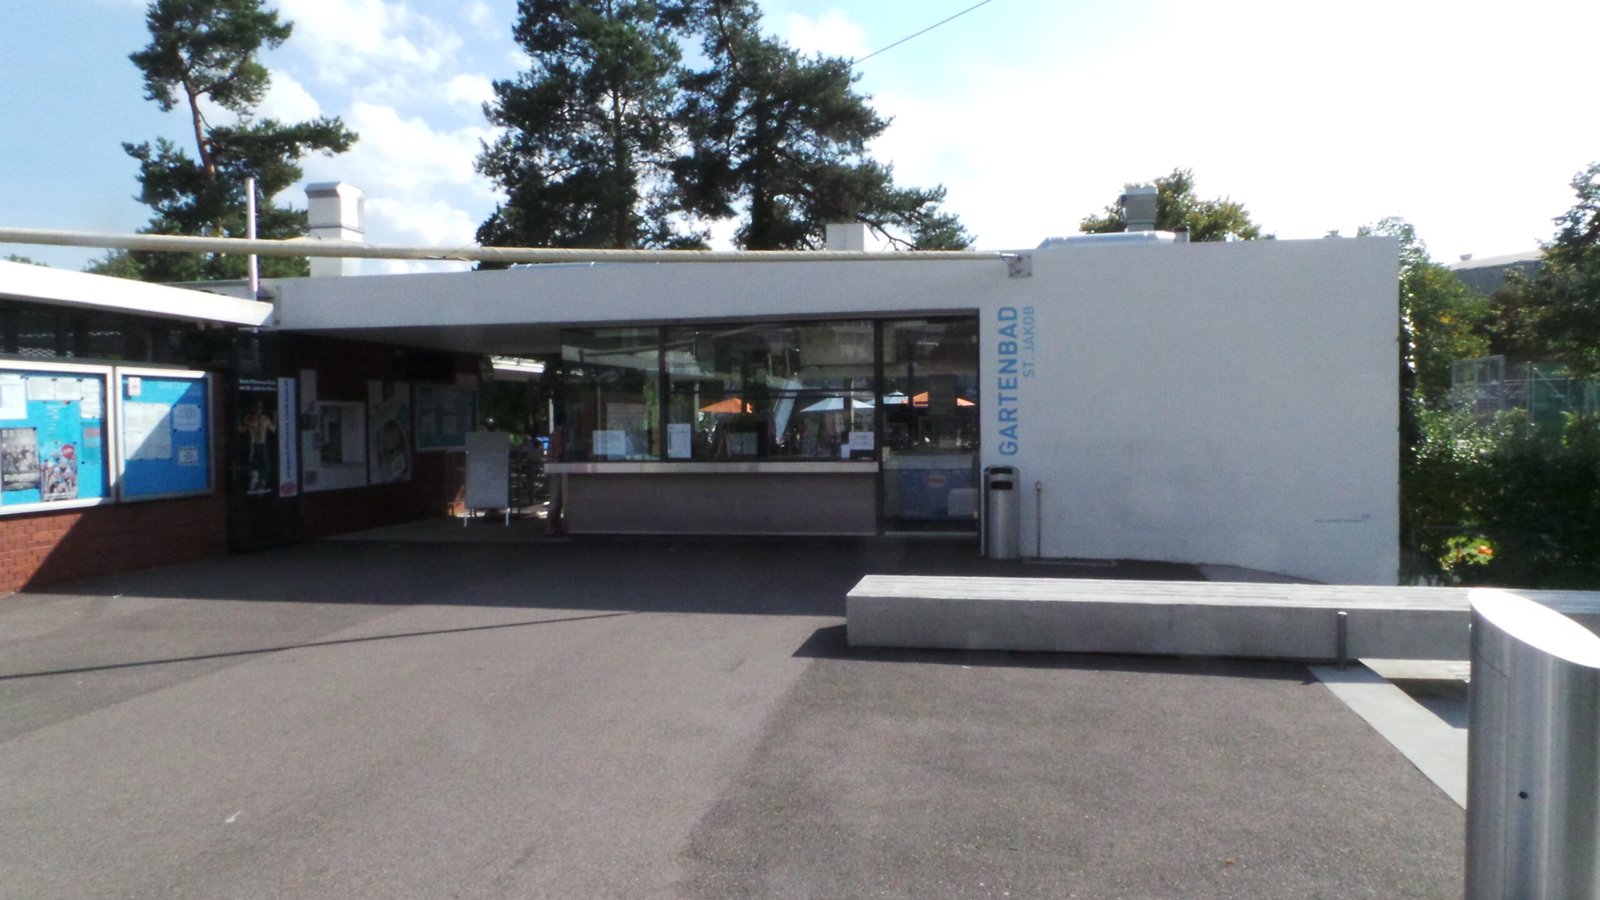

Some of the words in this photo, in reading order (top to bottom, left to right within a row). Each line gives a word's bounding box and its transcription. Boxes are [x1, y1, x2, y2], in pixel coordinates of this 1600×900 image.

[1023, 306, 1035, 353] JAKOB
[998, 307, 1018, 456] GARTENBAD
[1023, 357, 1035, 378] ST.
